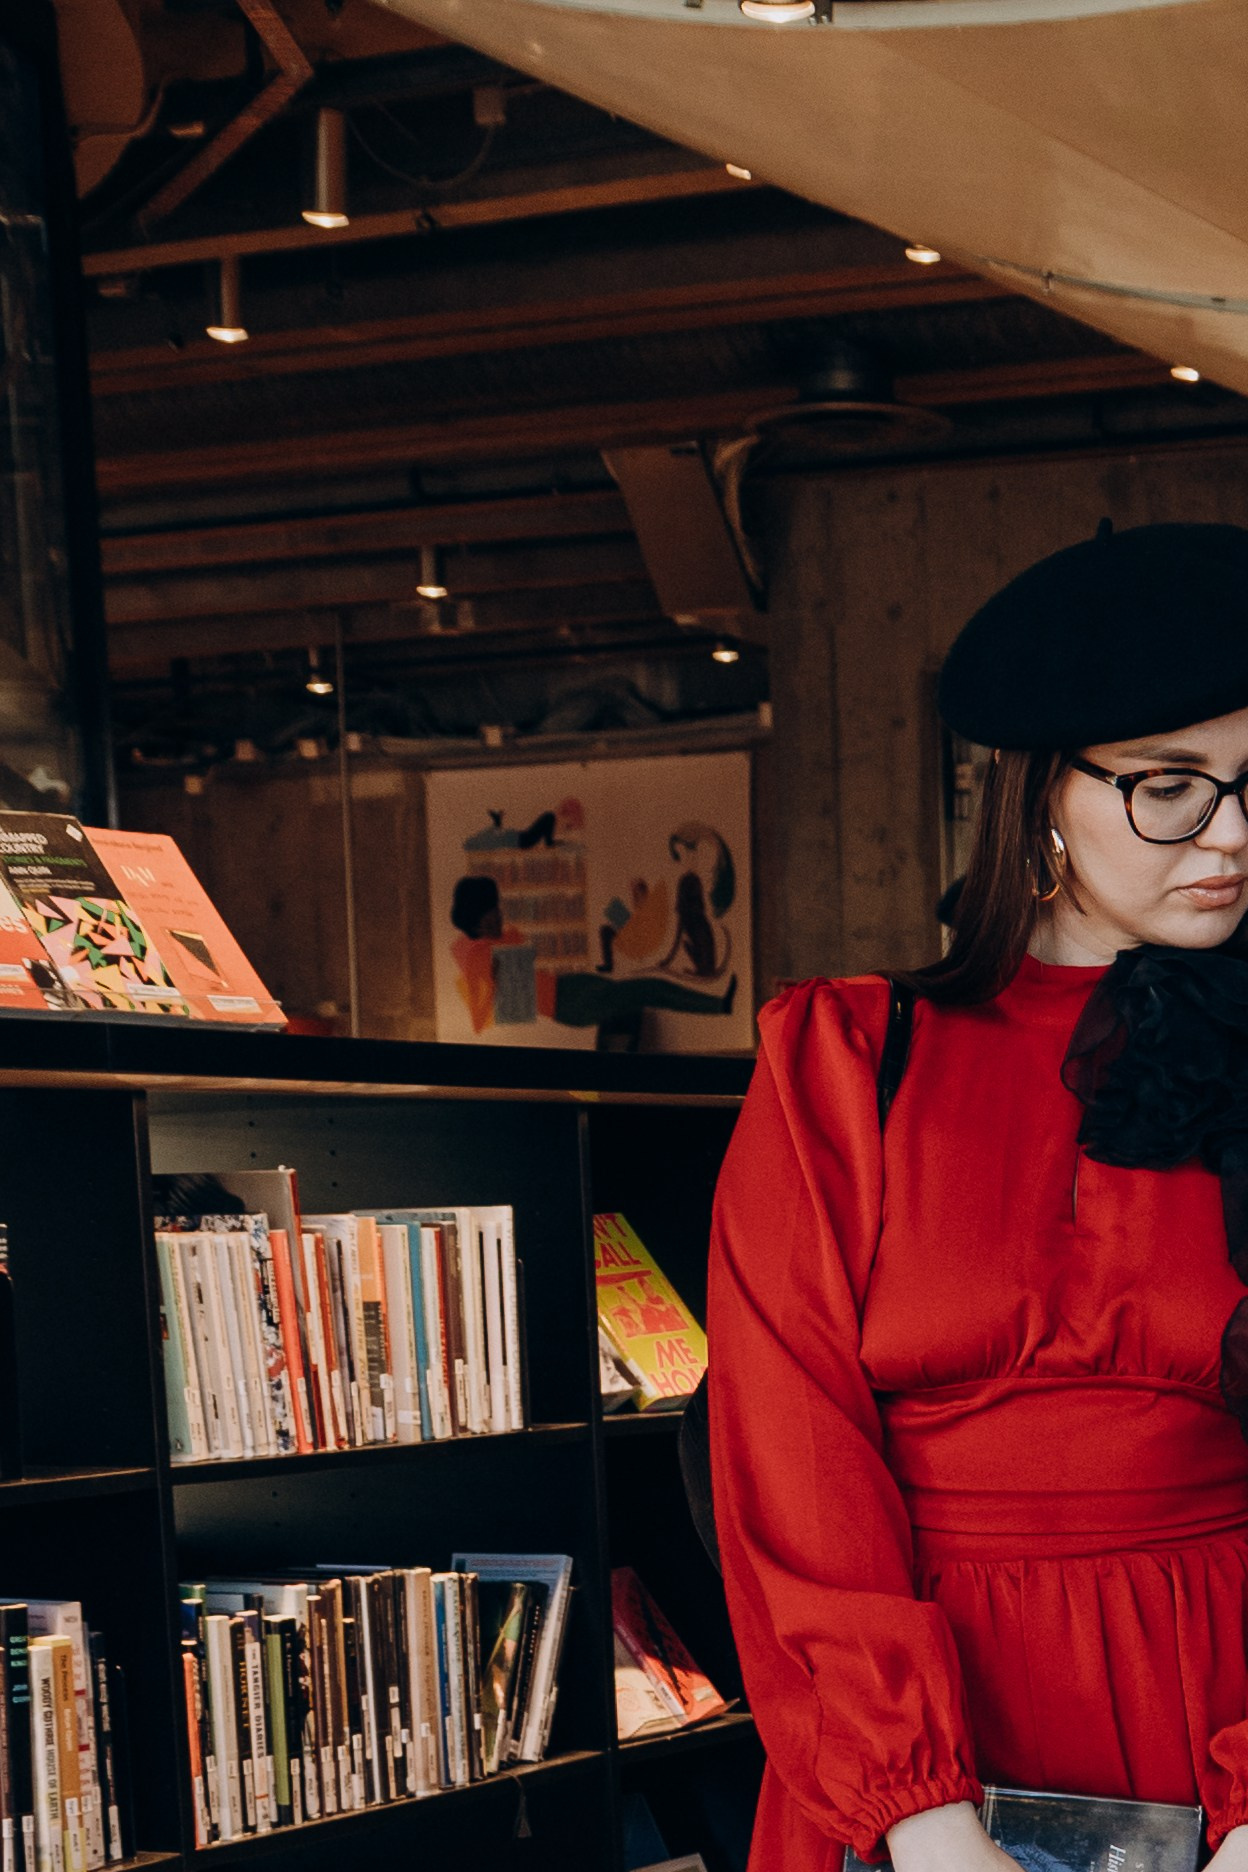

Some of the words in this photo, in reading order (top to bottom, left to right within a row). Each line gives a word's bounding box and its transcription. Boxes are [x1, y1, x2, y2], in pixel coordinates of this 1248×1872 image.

[655, 1338, 697, 1368] ME
[650, 1366, 707, 1398] HOM
[41, 1677, 51, 1708] WOODY
[252, 1665, 261, 1710] TANGIER
[44, 1711, 54, 1747] GUTHRIE
[254, 1715, 264, 1759] DIARIES
[47, 1749, 56, 1777] HOUSE
[49, 1779, 57, 1789] OF
[49, 1792, 59, 1820] EARTH
